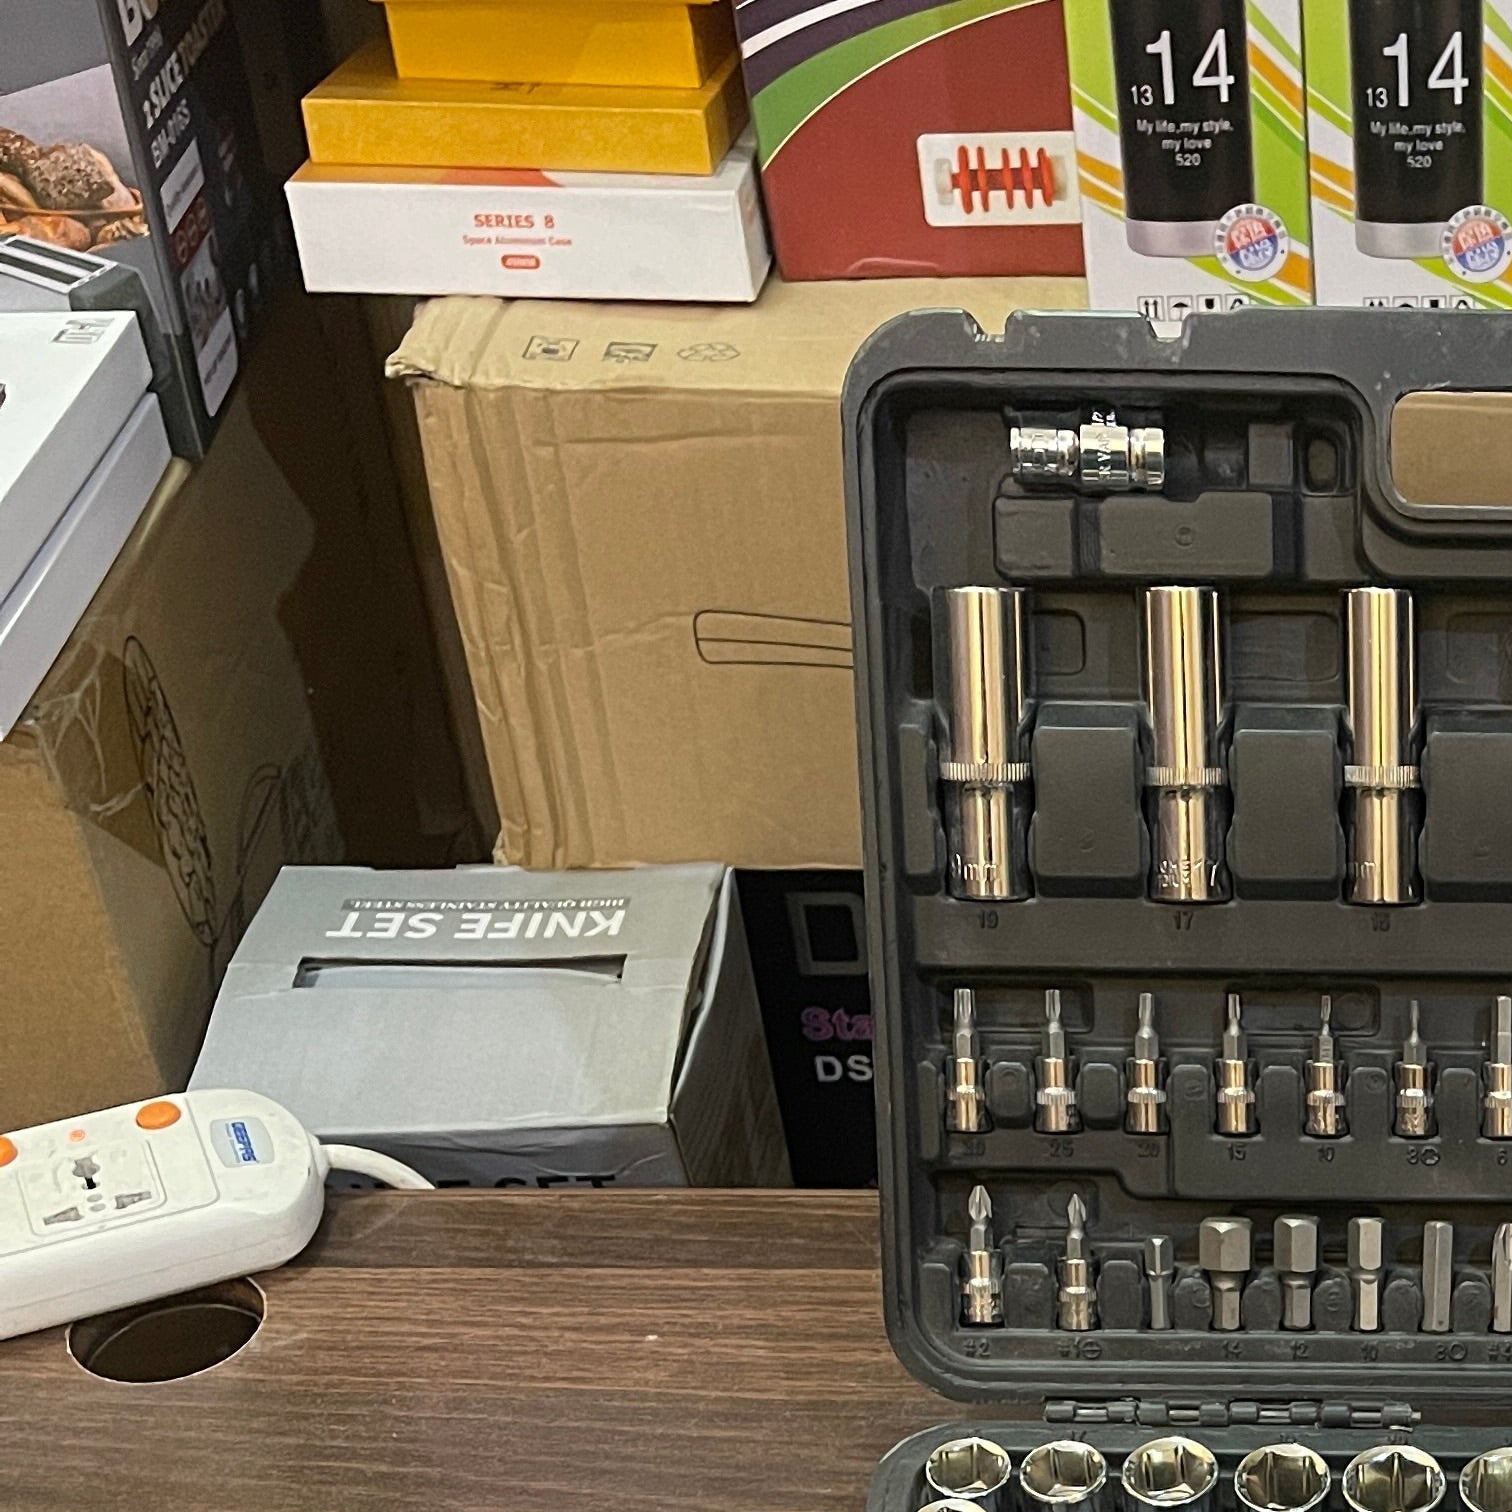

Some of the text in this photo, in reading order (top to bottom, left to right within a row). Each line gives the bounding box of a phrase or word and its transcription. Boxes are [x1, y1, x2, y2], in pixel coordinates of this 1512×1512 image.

[1130, 28, 1235, 106] 13 14
[1366, 31, 1469, 108] 13 14
[1184, 137, 1212, 150] love
[1416, 139, 1443, 151] love
[1175, 153, 1201, 166] 520
[1406, 155, 1432, 168] 520
[474, 213, 555, 228] SERIES 8
[325, 910, 627, 939] KNIFE SET
[1173, 911, 1194, 931] 17
[1227, 1145, 1246, 1161] 15
[1317, 1147, 1335, 1163] 10
